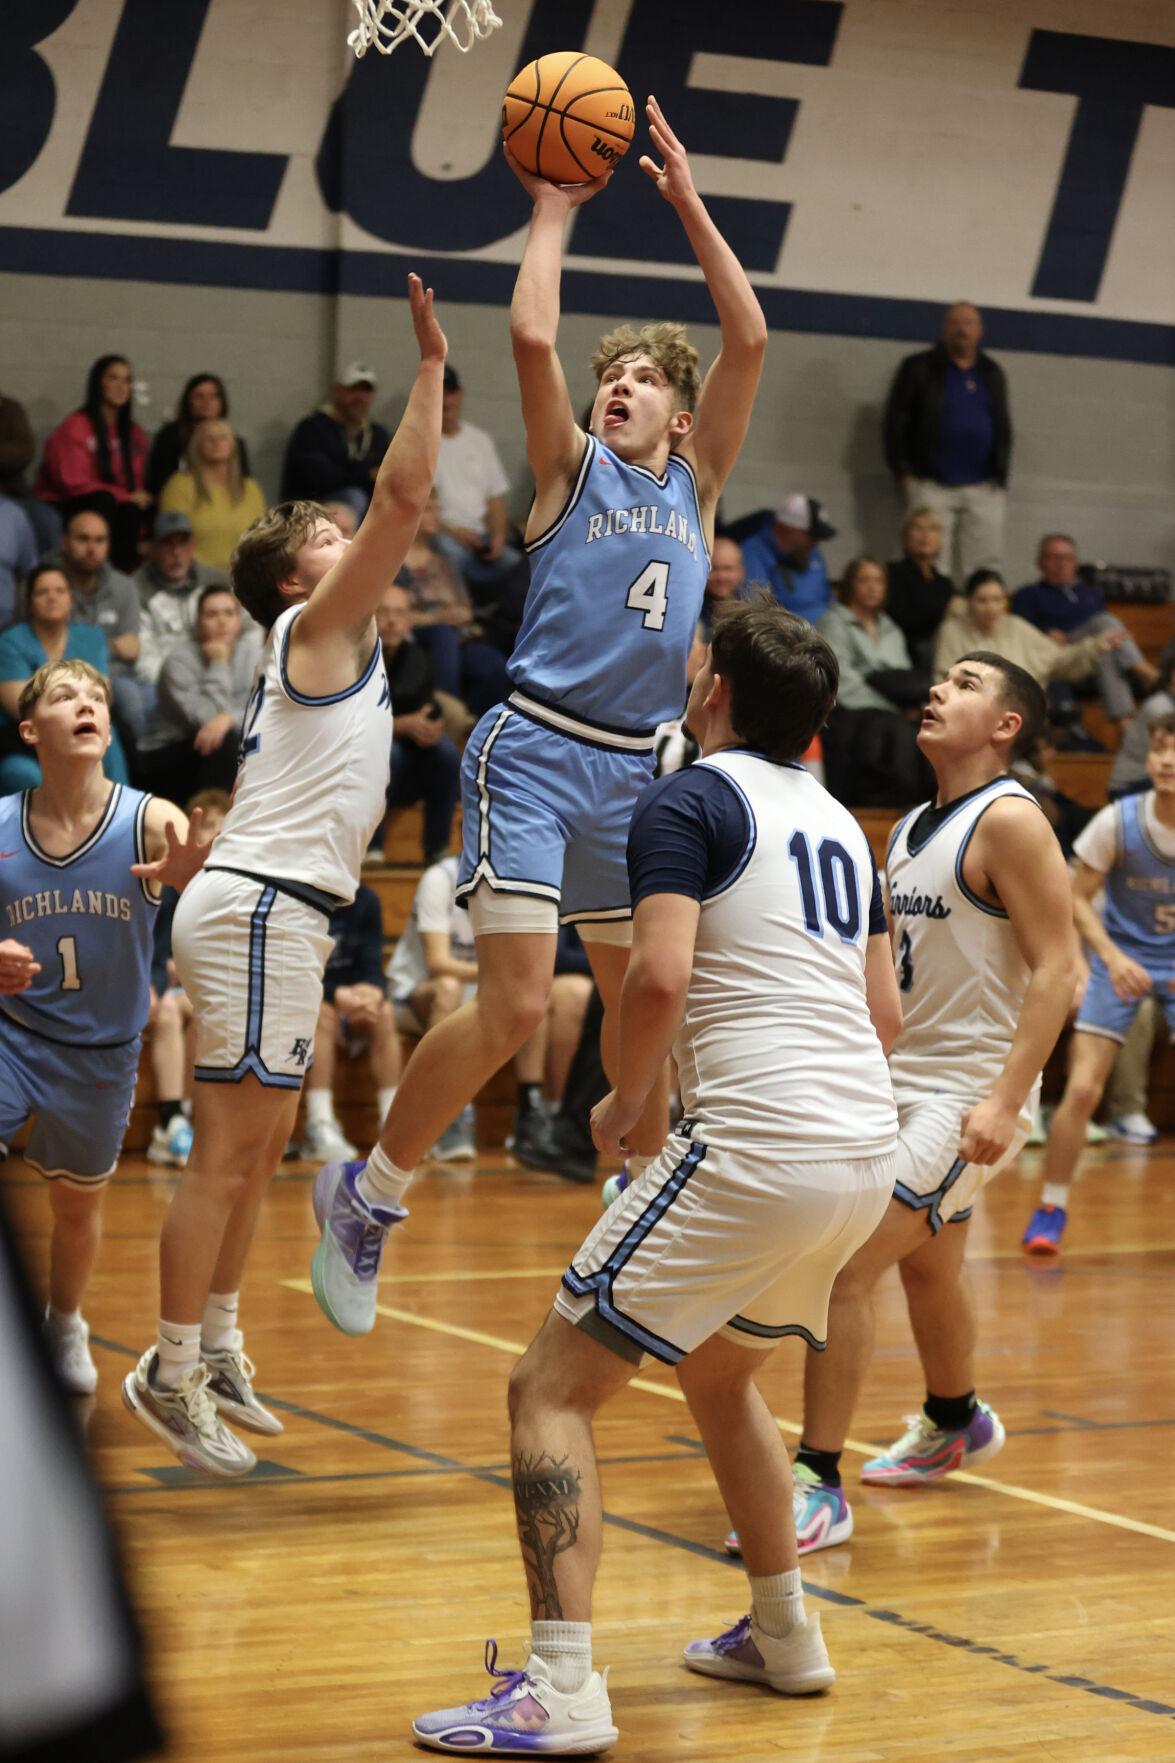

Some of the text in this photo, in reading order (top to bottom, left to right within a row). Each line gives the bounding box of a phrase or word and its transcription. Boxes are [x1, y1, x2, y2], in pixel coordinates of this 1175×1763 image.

[624, 559, 671, 632] 4
[787, 827, 862, 945] 10
[57, 934, 82, 991] 1
